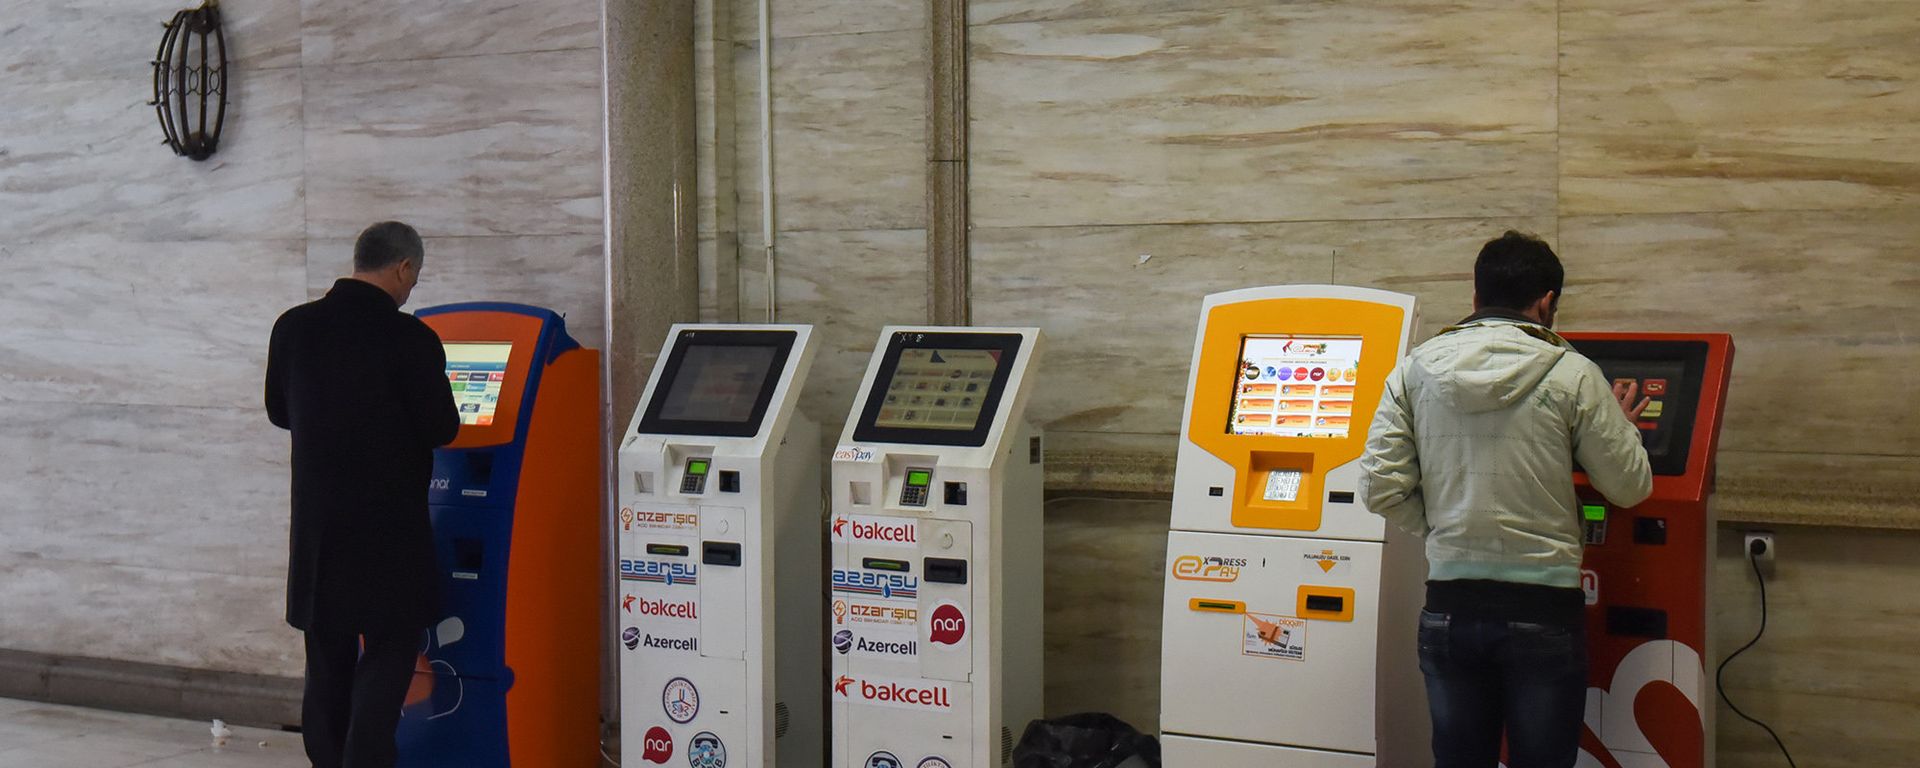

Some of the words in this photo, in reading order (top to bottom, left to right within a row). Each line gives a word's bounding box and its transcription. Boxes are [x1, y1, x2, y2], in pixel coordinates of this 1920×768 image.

[834, 448, 874, 461] easypay
[852, 520, 916, 543] bakcell
[620, 559, 697, 577] azarsu
[833, 570, 917, 589] azarsu
[640, 598, 697, 619] bakcell
[933, 617, 963, 632] nar
[643, 633, 697, 651] Azercell
[857, 636, 917, 655] Azercell
[861, 680, 950, 707] bakcell
[645, 736, 672, 753] nar
